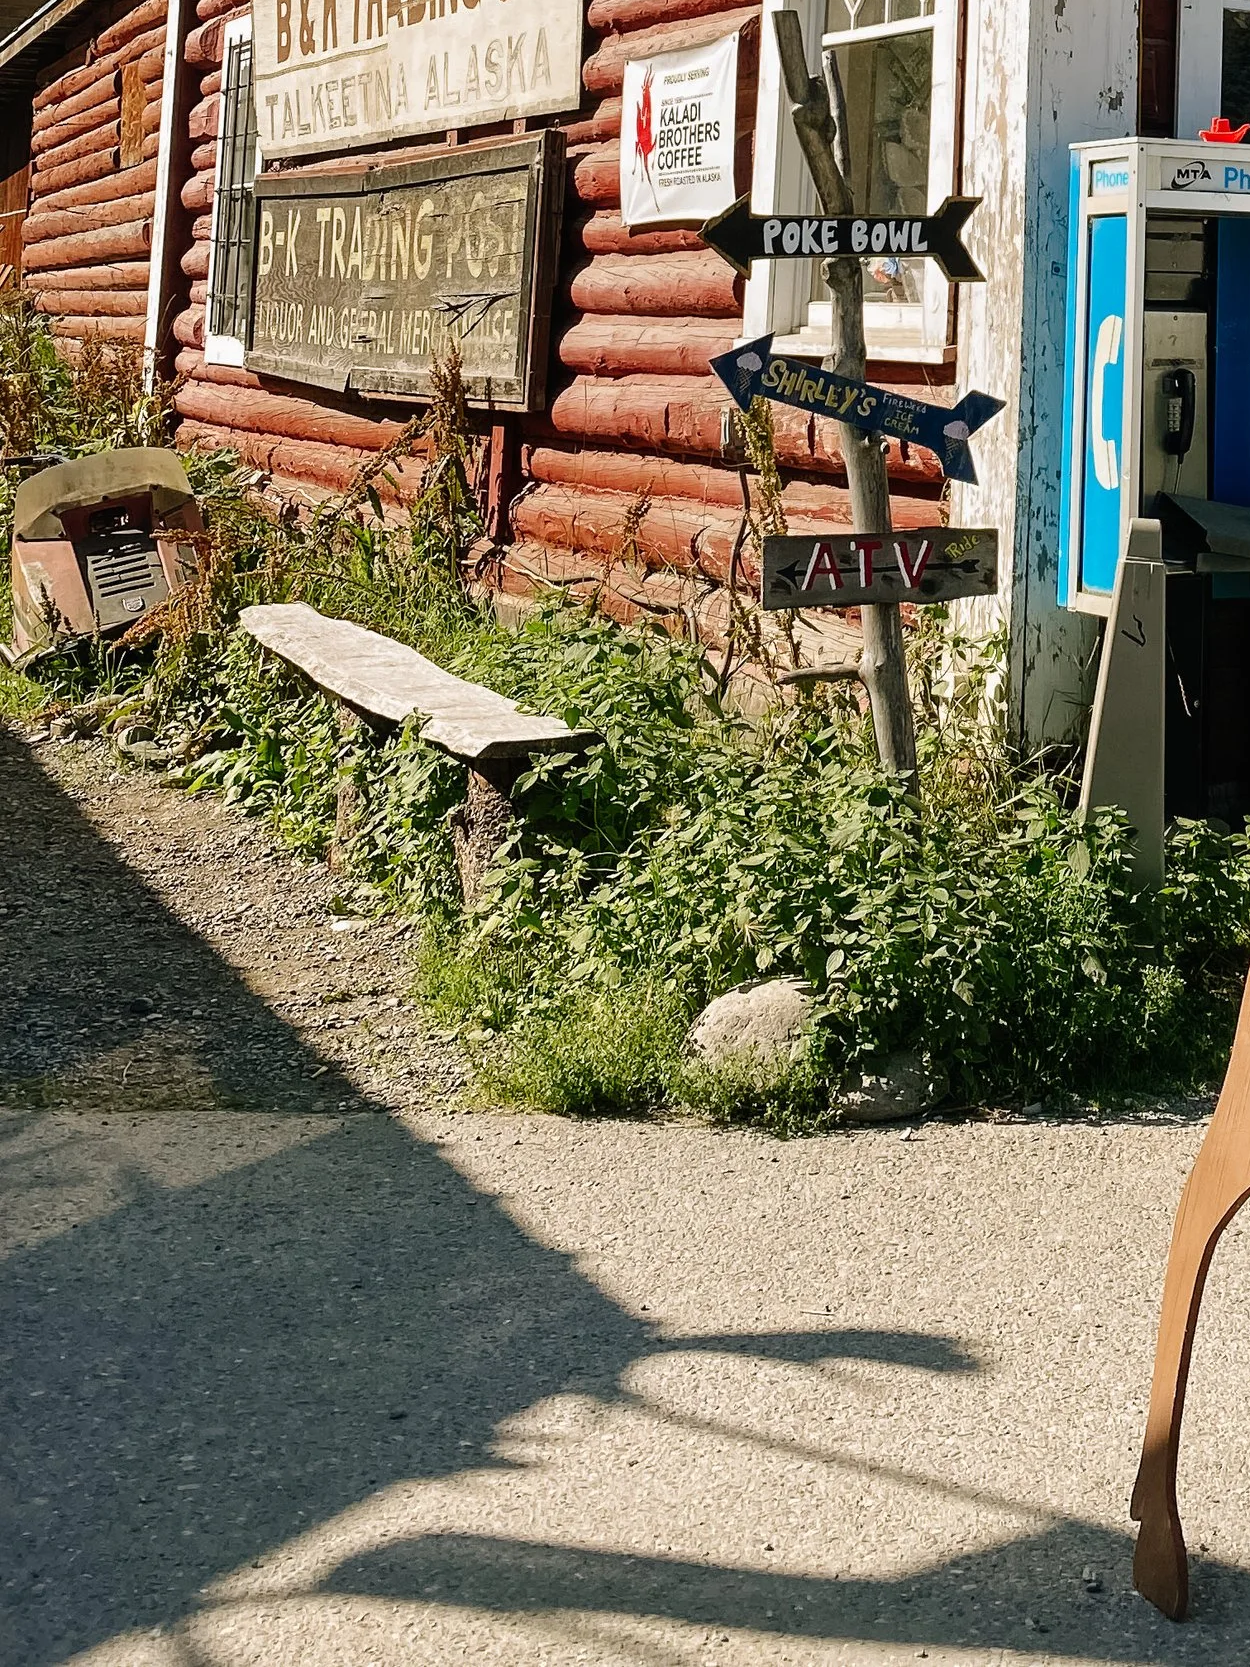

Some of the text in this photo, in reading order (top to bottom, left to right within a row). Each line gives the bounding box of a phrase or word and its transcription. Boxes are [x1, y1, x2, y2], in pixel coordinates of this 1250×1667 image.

[265, 26, 552, 140] TALKEETNA ALASKA
[660, 101, 701, 127] KALADI
[659, 120, 720, 149] BROTHERS
[658, 146, 702, 170] COFFEE
[1095, 169, 1129, 189] Phone
[1176, 168, 1212, 180] MTA
[316, 198, 435, 281] TRADING
[763, 218, 929, 255] POKE BOWL
[258, 300, 303, 345] LIQUOR
[308, 304, 335, 346] AND
[761, 359, 877, 416] SHIRLEY'S
[884, 417, 919, 435] CREAM
[895, 409, 914, 423] ICE
